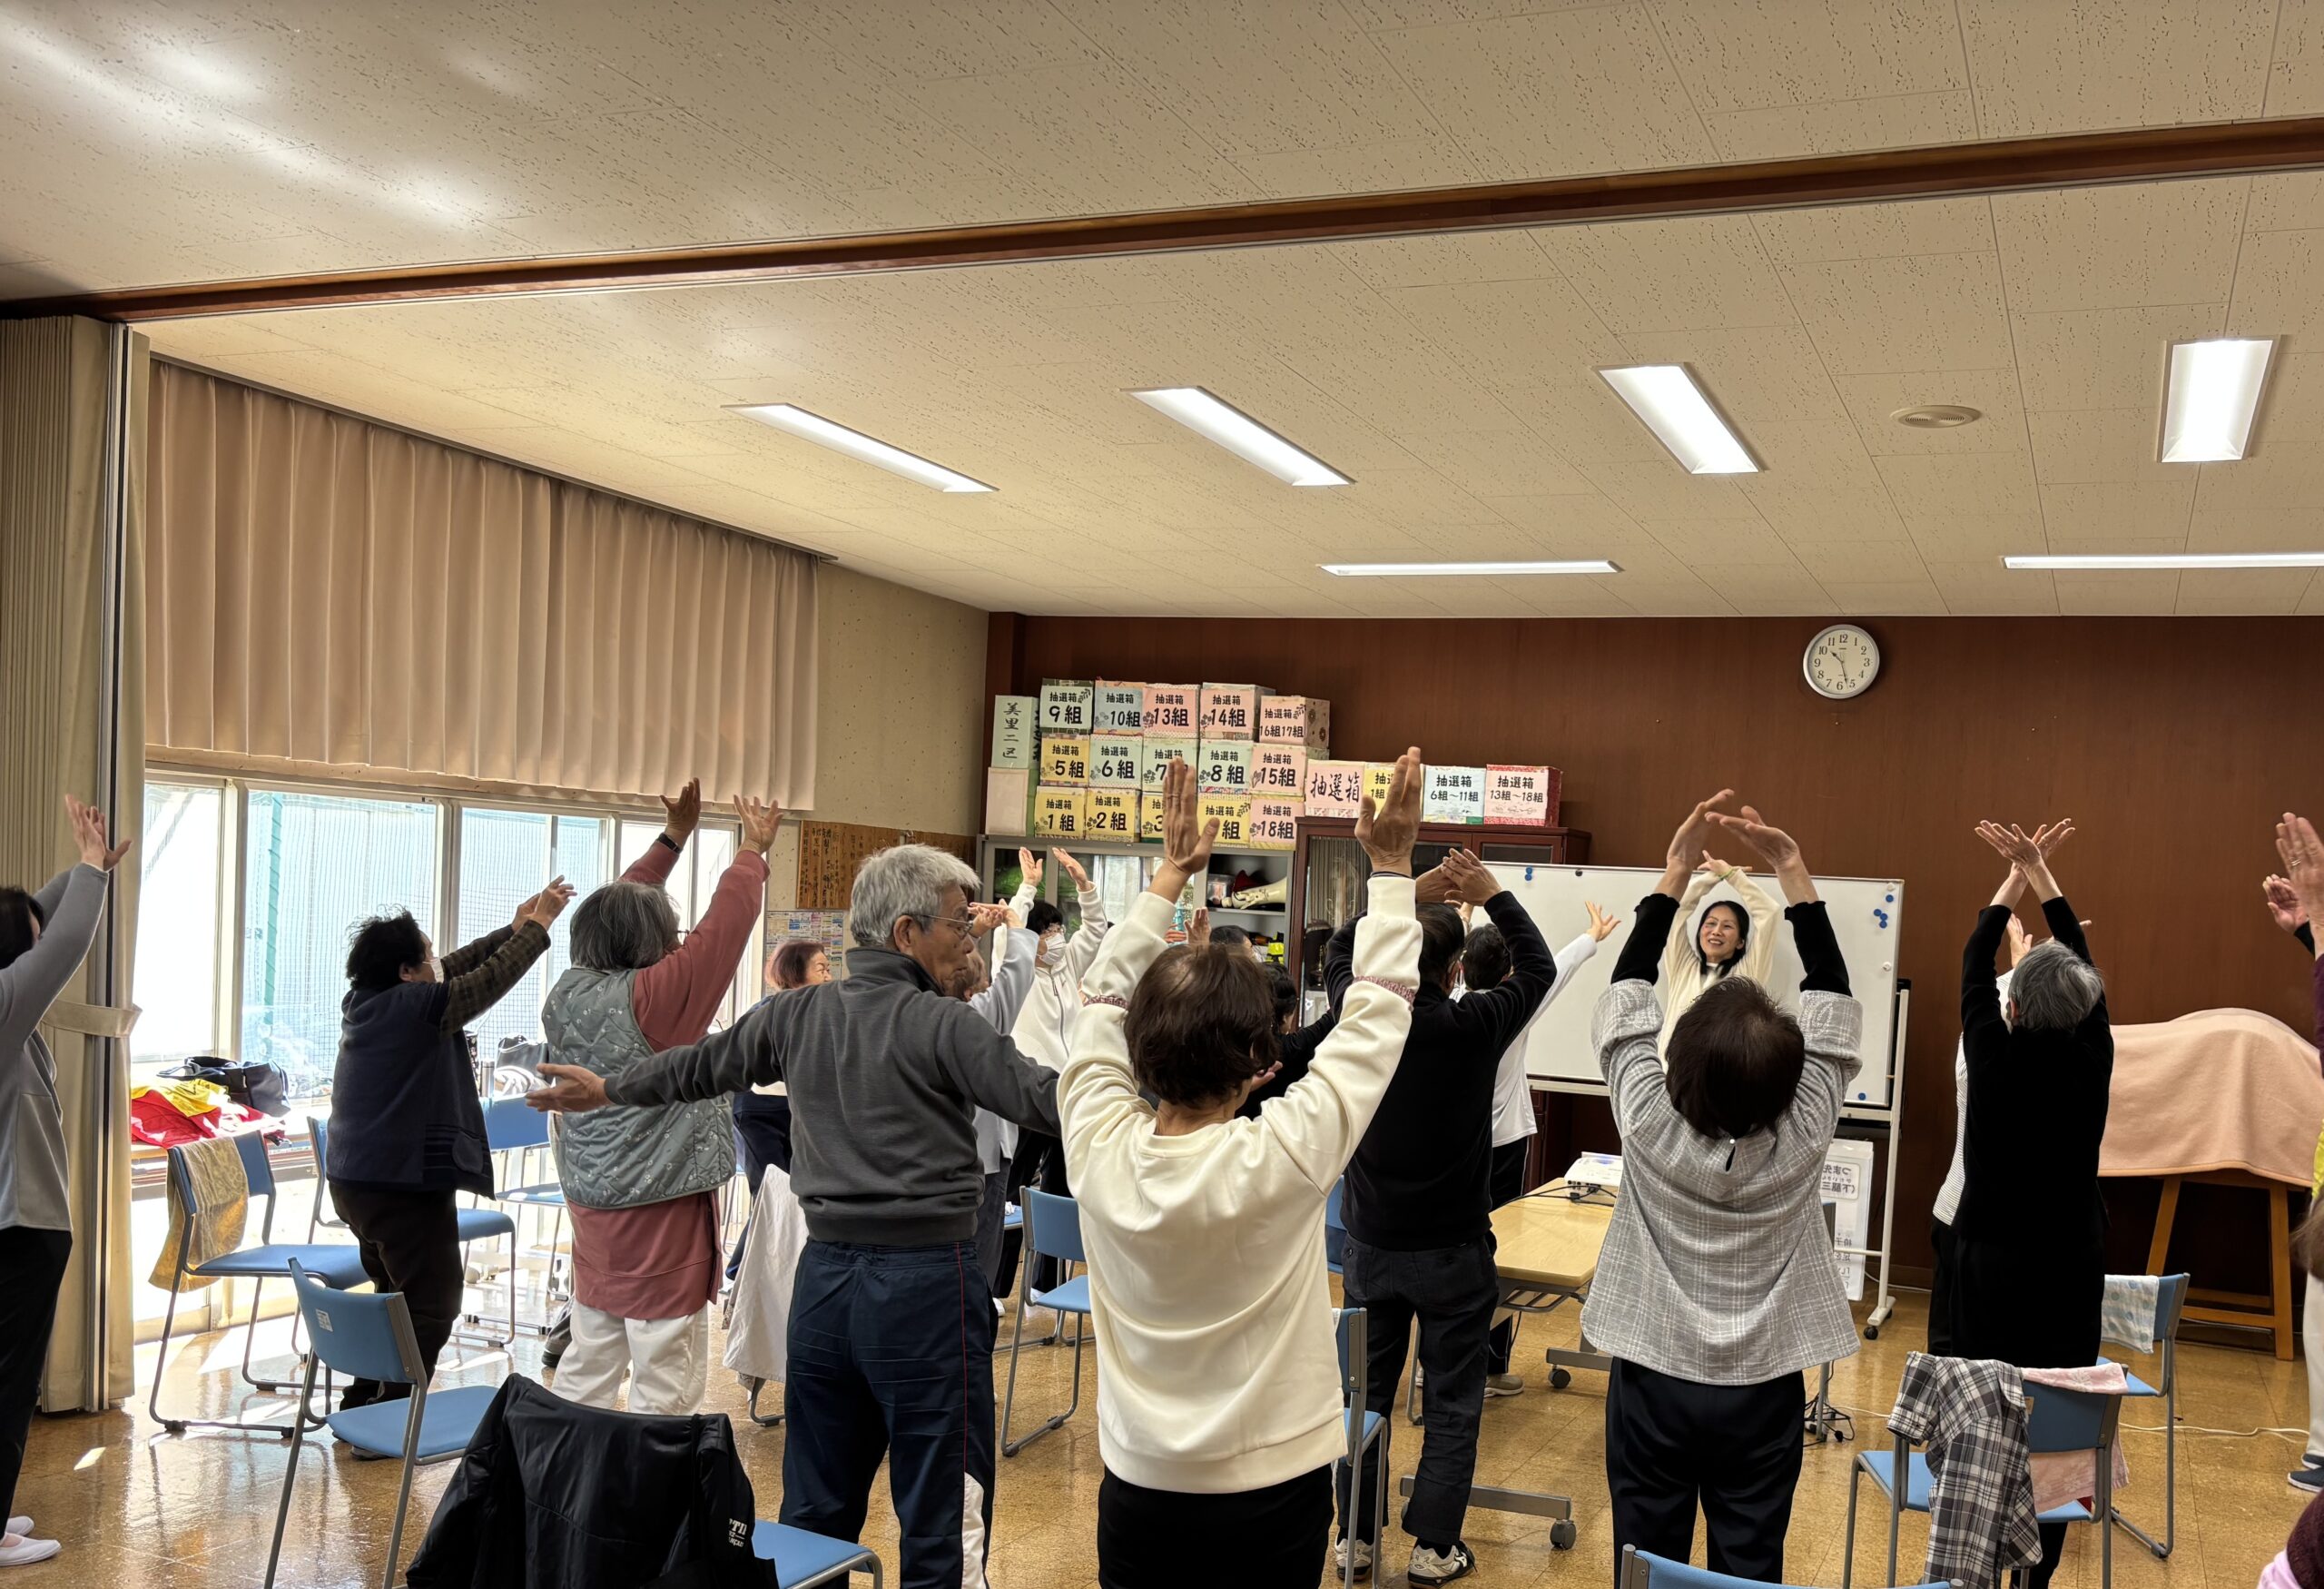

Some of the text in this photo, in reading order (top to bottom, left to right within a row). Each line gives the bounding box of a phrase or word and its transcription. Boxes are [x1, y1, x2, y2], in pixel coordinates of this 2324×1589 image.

[1827, 637, 1835, 646] 11
[1839, 634, 1848, 643] 12
[1854, 637, 1857, 646] 1
[1818, 646, 1827, 655] 10
[1861, 646, 1866, 655] 2
[1814, 658, 1821, 667] 9
[1864, 658, 1870, 666] 3
[1817, 670, 1824, 678] 8
[1858, 670, 1864, 678] 4
[1827, 679, 1832, 687] 7
[1837, 681, 1843, 690] 6
[1849, 679, 1856, 688] 5
[1049, 692, 1078, 703] 抽選箱
[1106, 693, 1134, 704] 抽選箱
[1155, 694, 1184, 706] 抽選箱
[1212, 695, 1241, 706] 抽選箱
[1049, 705, 1082, 725] 9組
[1110, 710, 1141, 727] 10組
[1154, 707, 1189, 726] 13組
[1210, 707, 1246, 727] 14組
[1265, 708, 1292, 719] 抽選箱
[1002, 702, 1022, 759] 美里二区
[1052, 744, 1079, 755] 抽選箱
[1101, 745, 1128, 756] 抽選箱
[1210, 751, 1239, 762] 抽選箱
[1263, 753, 1292, 765] 抽選箱
[1055, 760, 1085, 778] 5組
[1101, 759, 1135, 779] 6組
[1210, 765, 1245, 785] 8組
[1260, 767, 1296, 786] 15組
[1436, 775, 1472, 787] 抽選箱
[1497, 775, 1534, 789] 抽選箱
[1310, 772, 1360, 803] 抽選箱
[1046, 798, 1072, 810] 抽選箱
[1095, 795, 1121, 807] 抽選箱
[1206, 804, 1235, 817] 抽選箱
[1263, 804, 1292, 817] 抽選箱
[1048, 814, 1075, 832] 1組
[1096, 812, 1128, 831] 2組
[1222, 820, 1241, 839] 組
[1260, 820, 1295, 839] 18組
